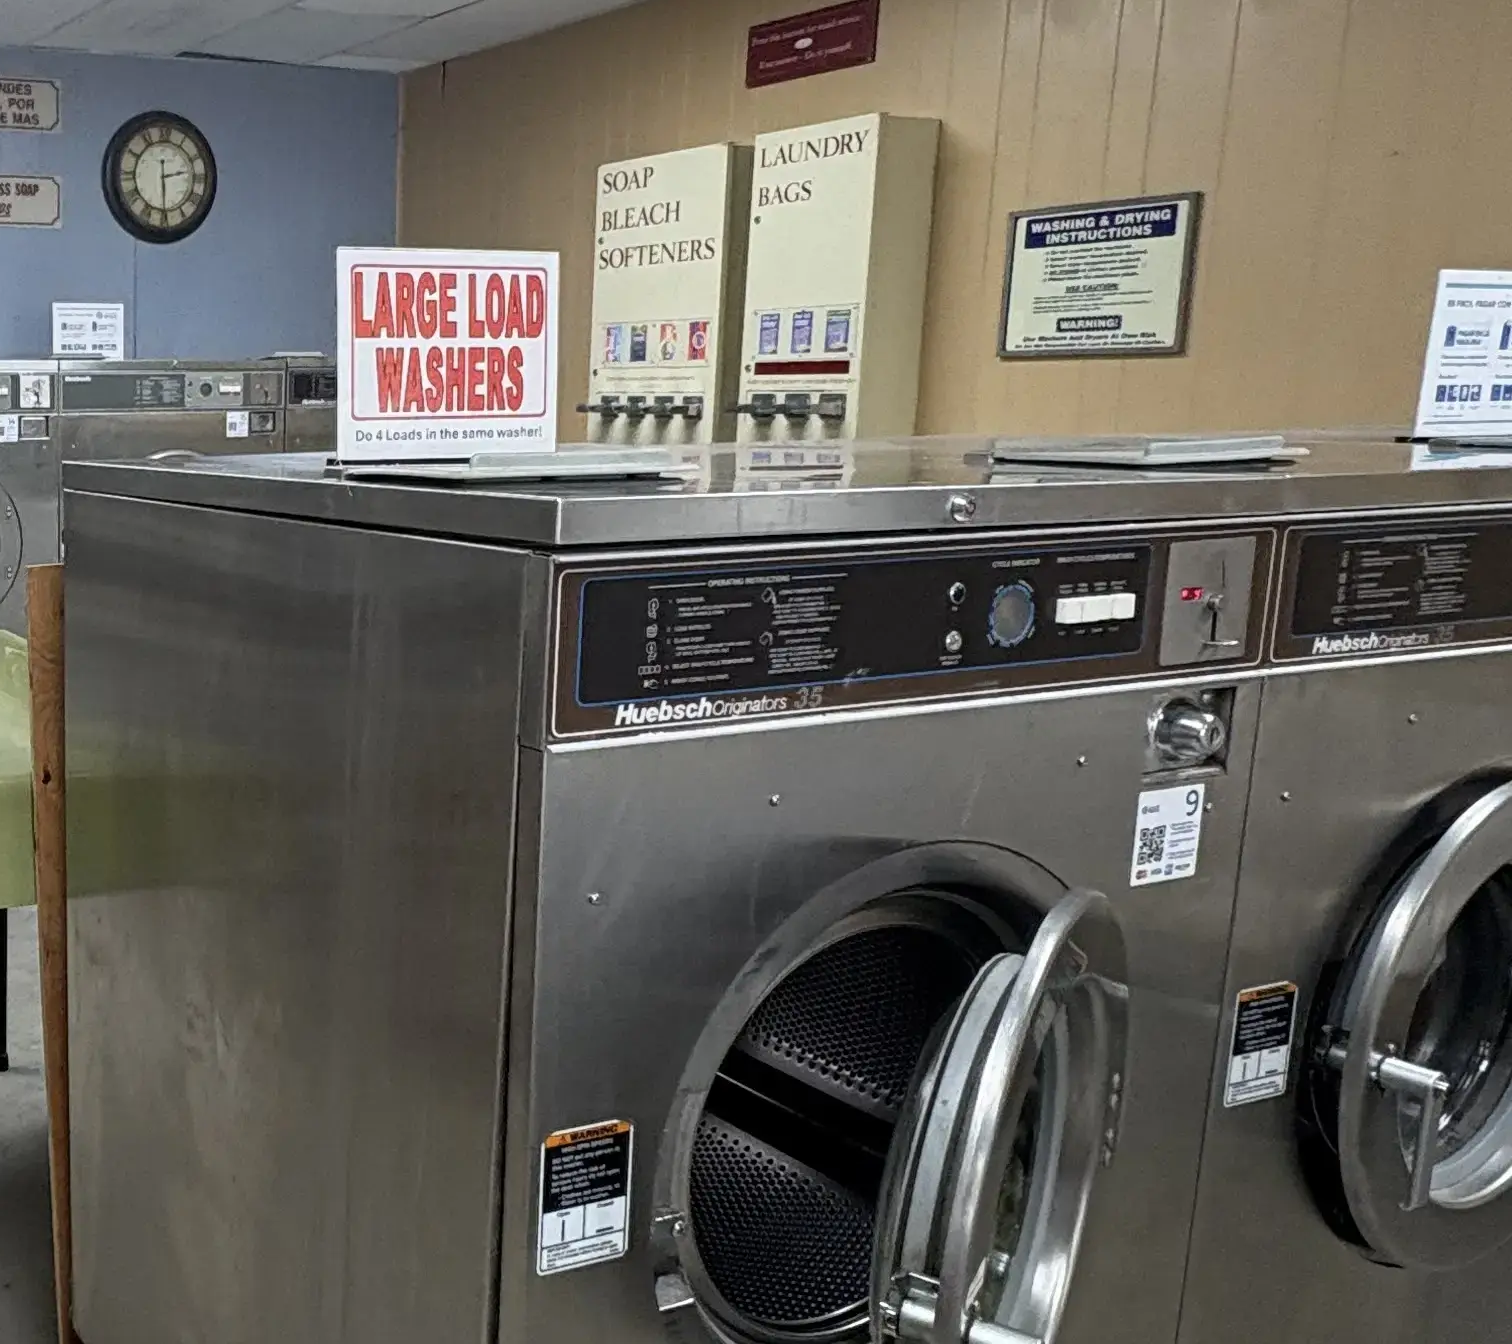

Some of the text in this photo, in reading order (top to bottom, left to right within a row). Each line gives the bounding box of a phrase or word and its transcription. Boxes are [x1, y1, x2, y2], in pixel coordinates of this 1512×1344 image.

[8, 98, 35, 111] POR
[12, 111, 40, 125] MAS
[760, 128, 871, 169] LAUNDRY
[15, 183, 40, 197] SOAP
[602, 166, 655, 195] SOAP
[758, 179, 813, 207] BAGS
[600, 200, 681, 232] BLEACH
[1031, 208, 1172, 234] WASHING & DRYING
[1045, 224, 1153, 245] INSTRUCTIONS
[598, 237, 716, 270] SOFTENERS
[354, 271, 544, 339] LARGE LOAD
[1059, 318, 1120, 330] WARNING!
[375, 346, 524, 413] WASHERS
[356, 426, 543, 442] Do 4 Loads in the same washer!
[1312, 632, 1379, 655] Huebsch
[614, 687, 824, 726] Huebsch Originators 35
[1186, 789, 1199, 816] 9
